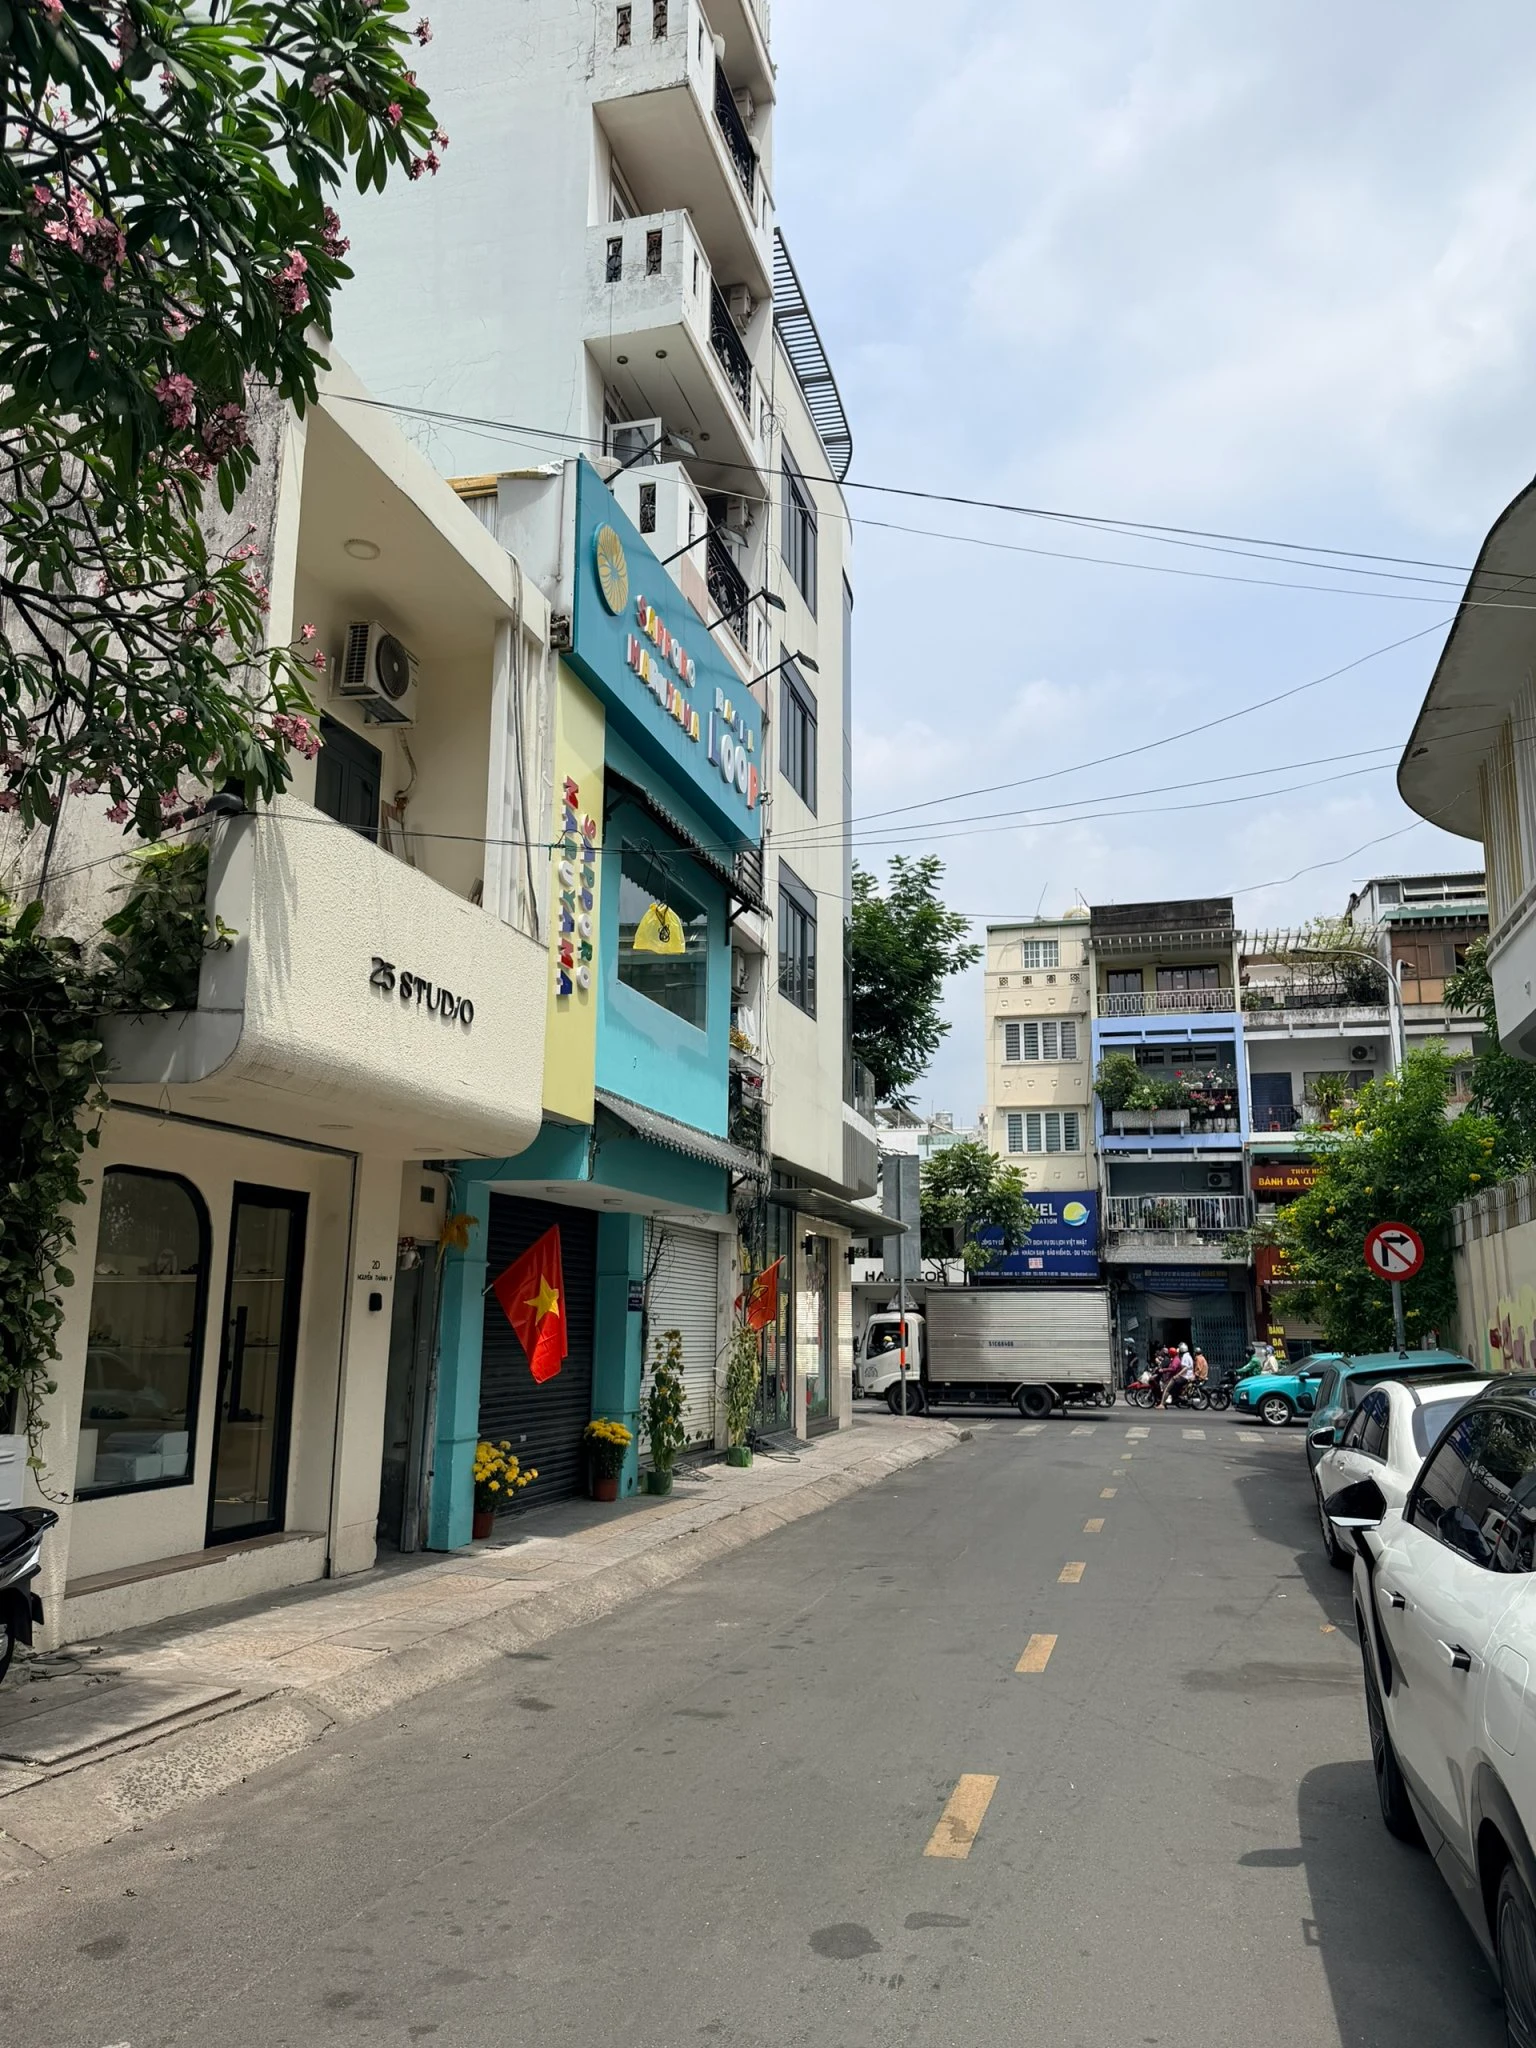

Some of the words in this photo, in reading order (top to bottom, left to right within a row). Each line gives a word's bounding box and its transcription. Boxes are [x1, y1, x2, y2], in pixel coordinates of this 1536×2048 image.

[708, 711, 758, 809] LOOP
[400, 971, 474, 1024] STUDIO
[1303, 1177, 1318, 1186] CU
